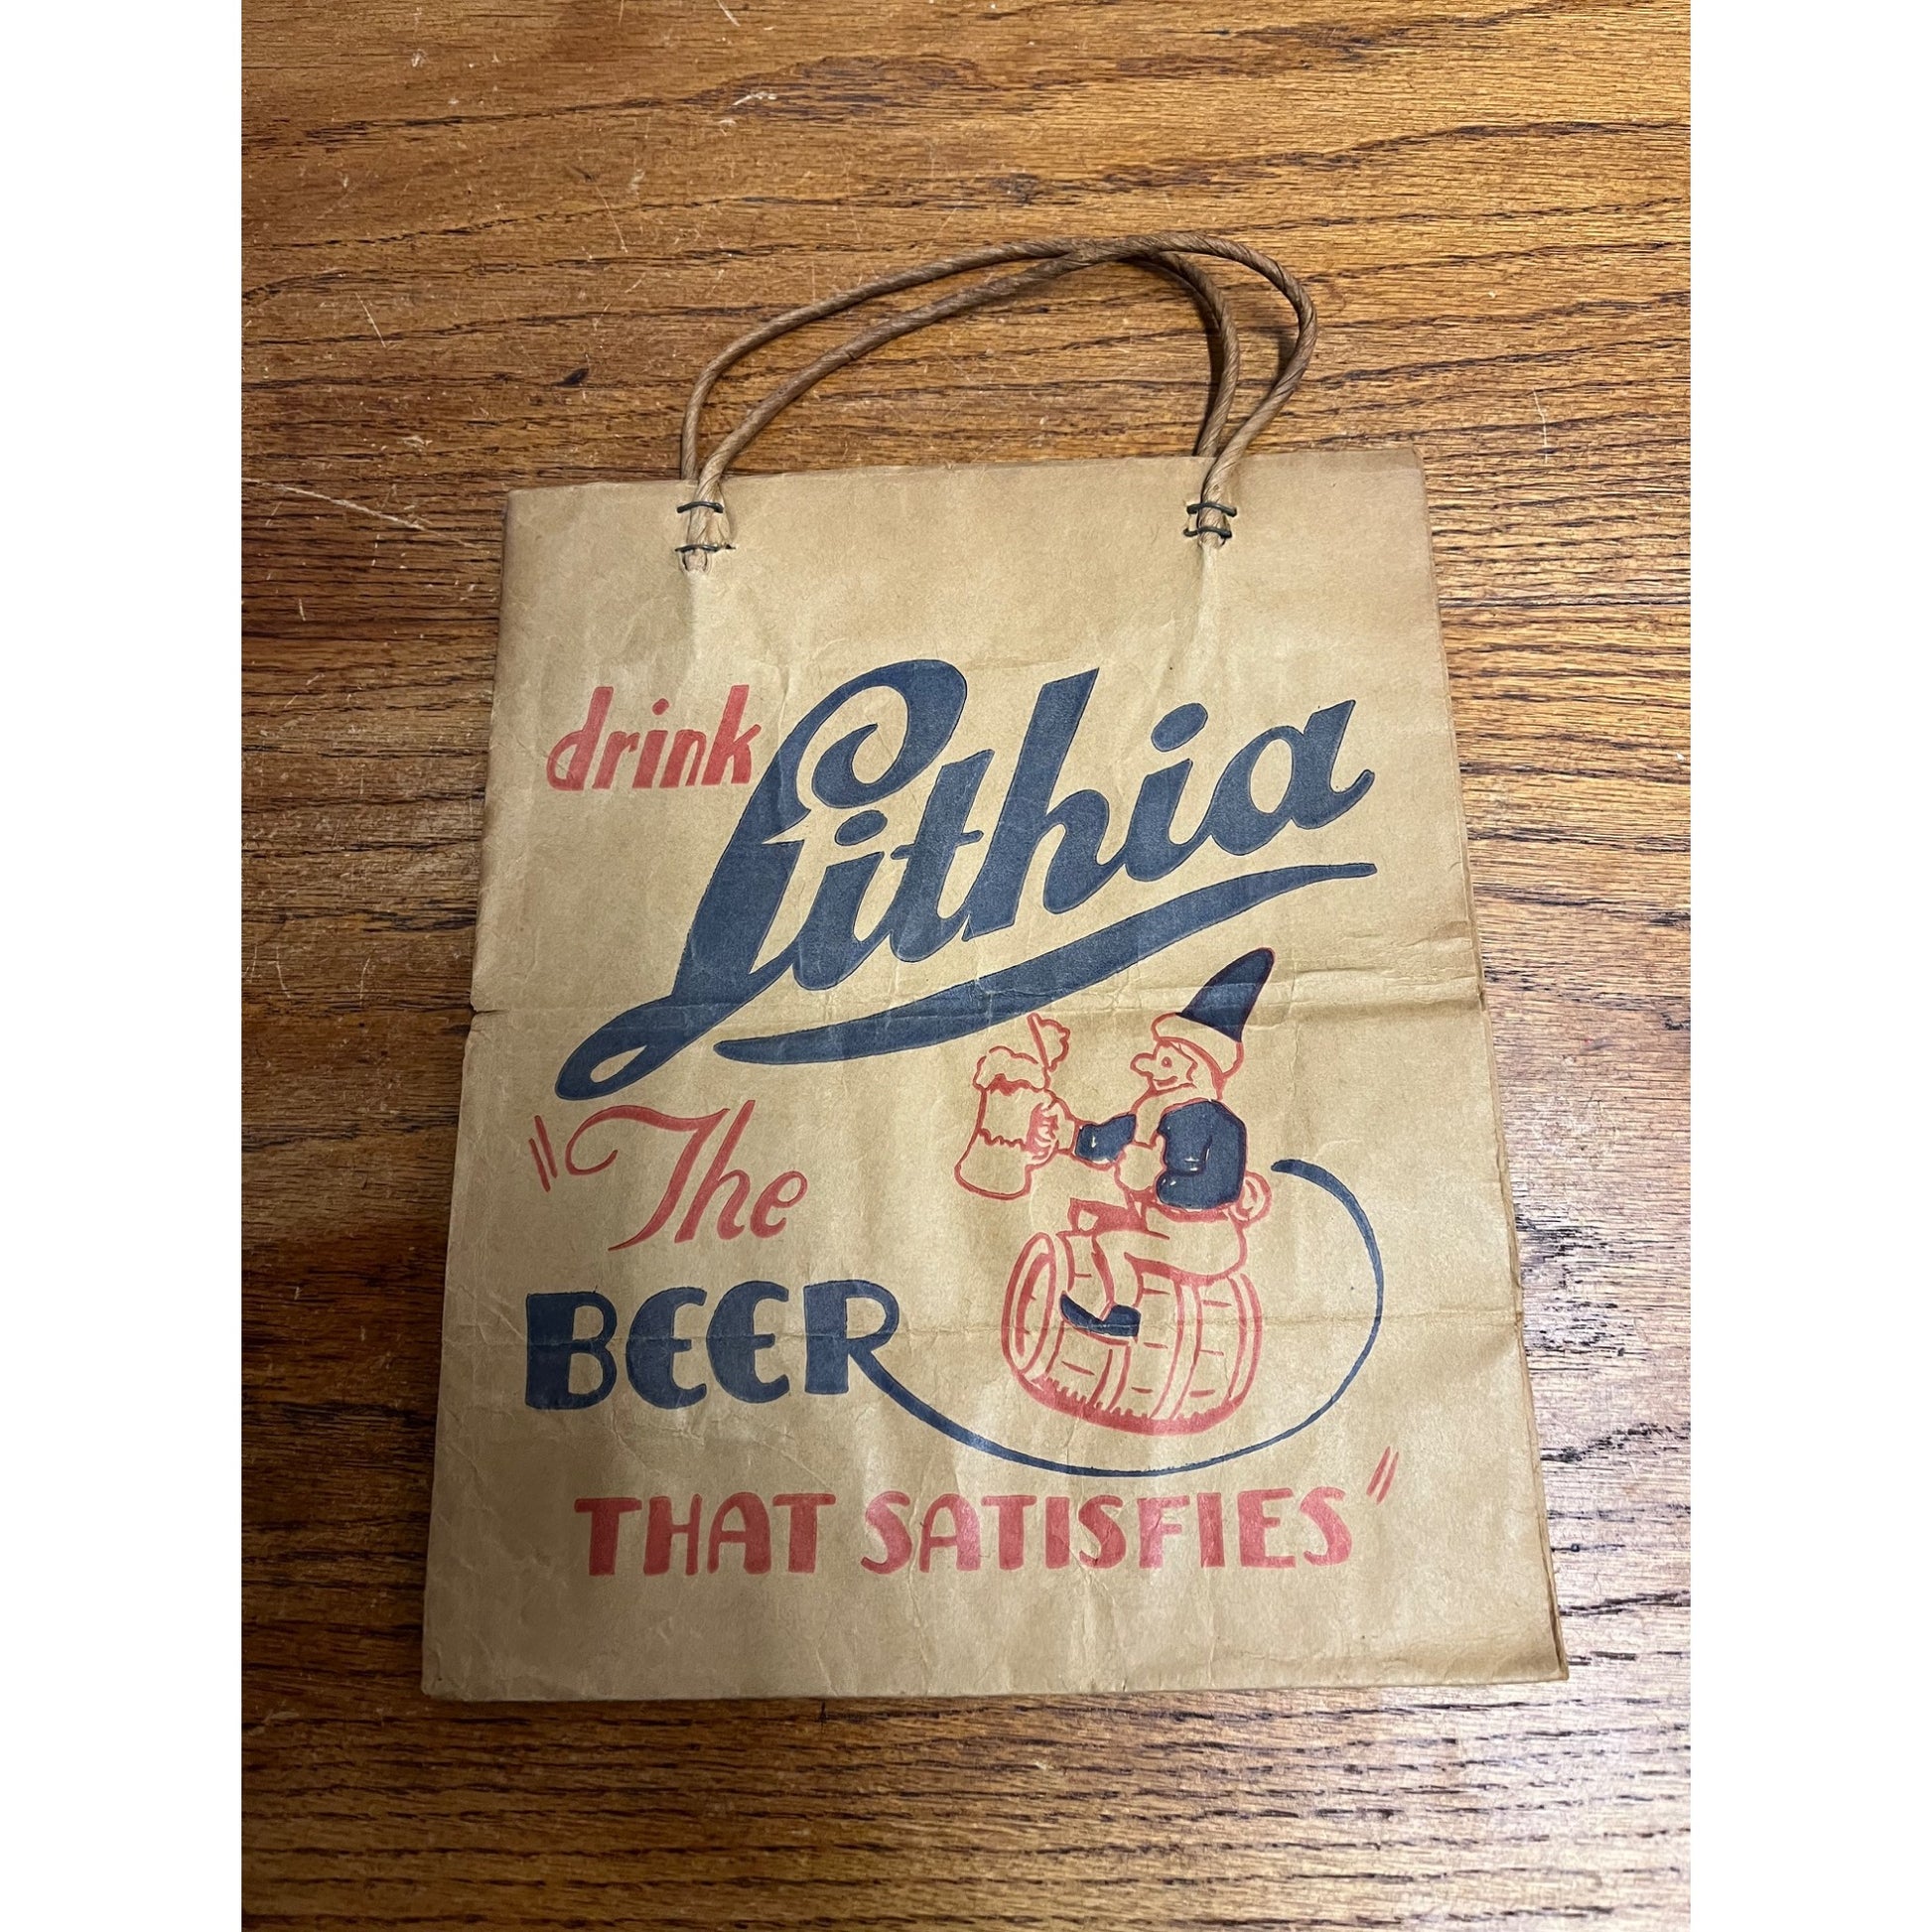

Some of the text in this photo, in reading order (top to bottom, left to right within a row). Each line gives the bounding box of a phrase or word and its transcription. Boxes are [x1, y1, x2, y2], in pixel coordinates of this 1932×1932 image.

[546, 658, 1376, 1100] drink Lithia
[524, 1279, 901, 1411] BEER
[573, 1491, 836, 1578] THAT
